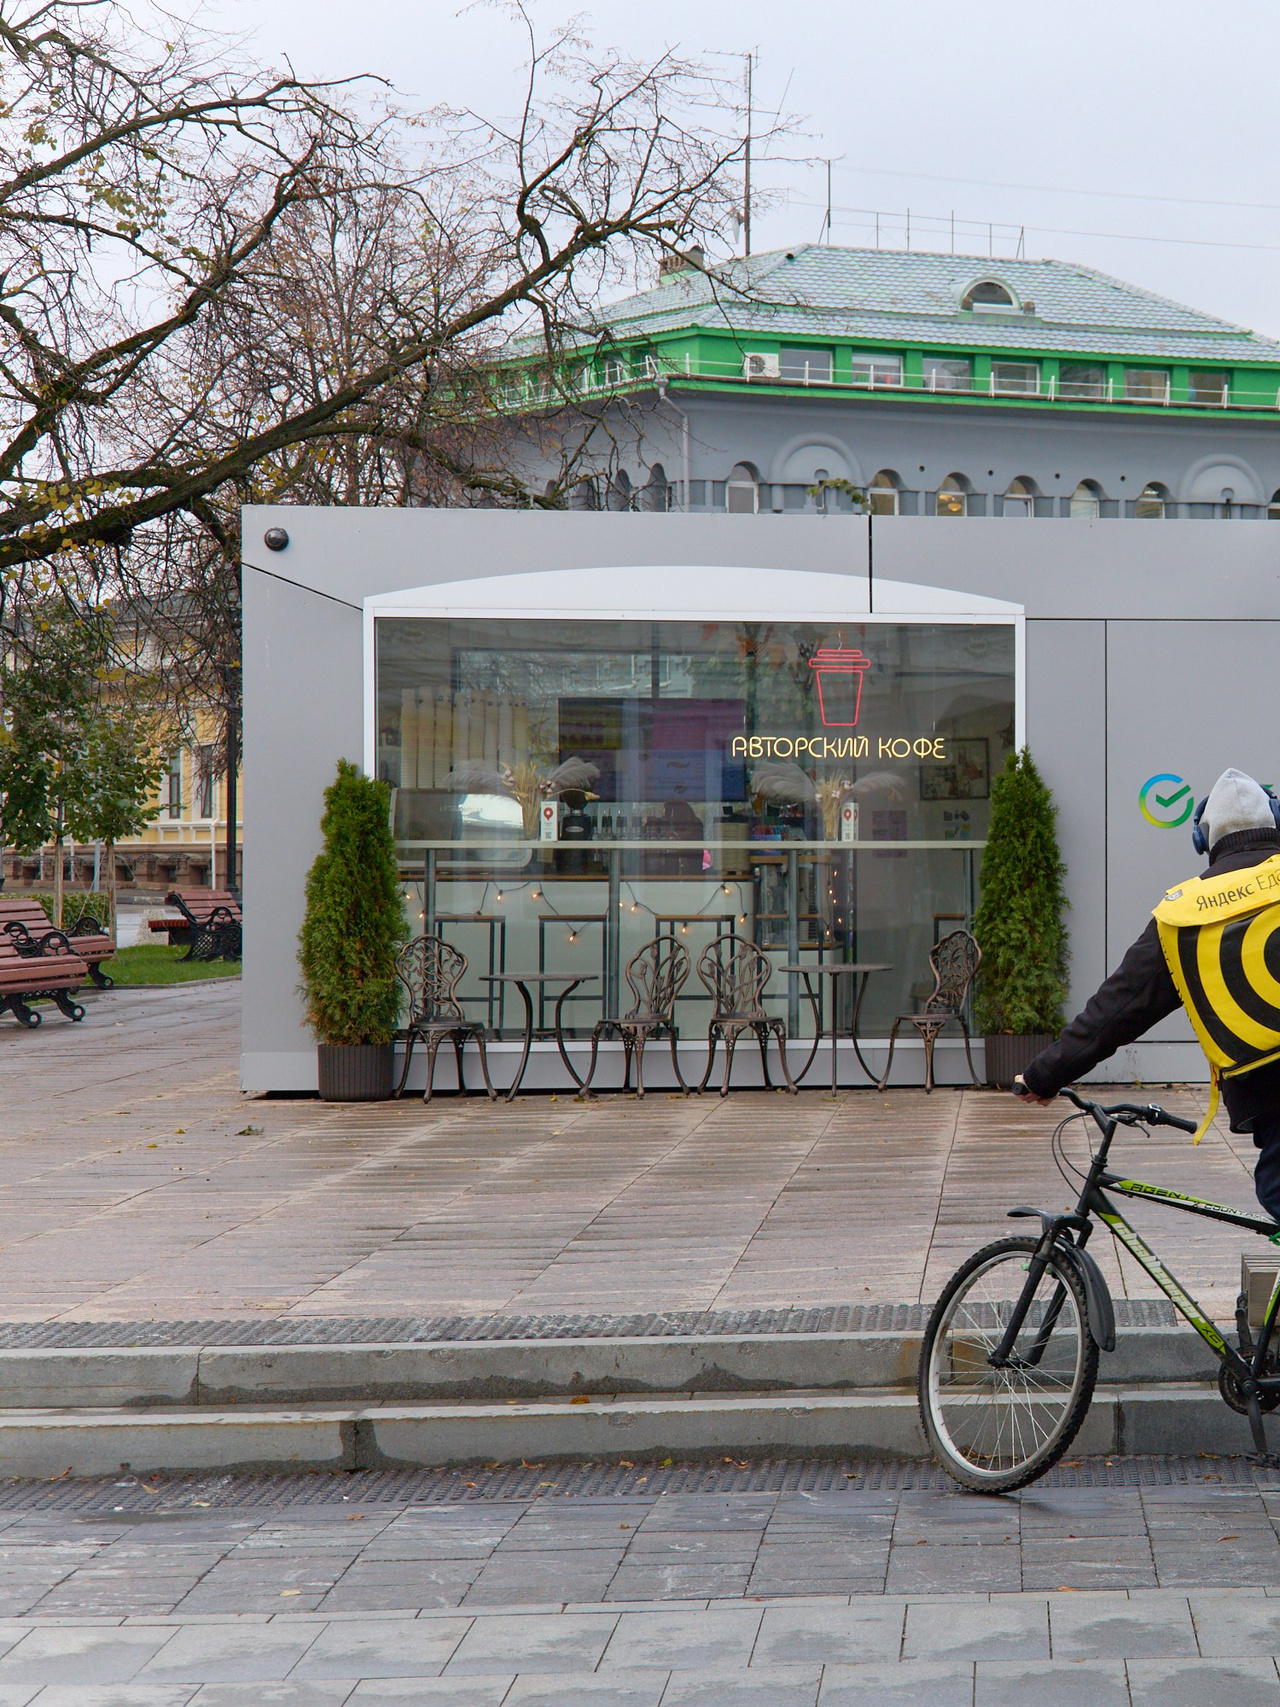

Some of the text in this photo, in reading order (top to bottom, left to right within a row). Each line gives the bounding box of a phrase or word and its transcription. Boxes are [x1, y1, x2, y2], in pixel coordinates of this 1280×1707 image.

[732, 735, 946, 759] АВТОРСКИЙ КОФЕ
[1196, 883, 1255, 912] Яндекс
